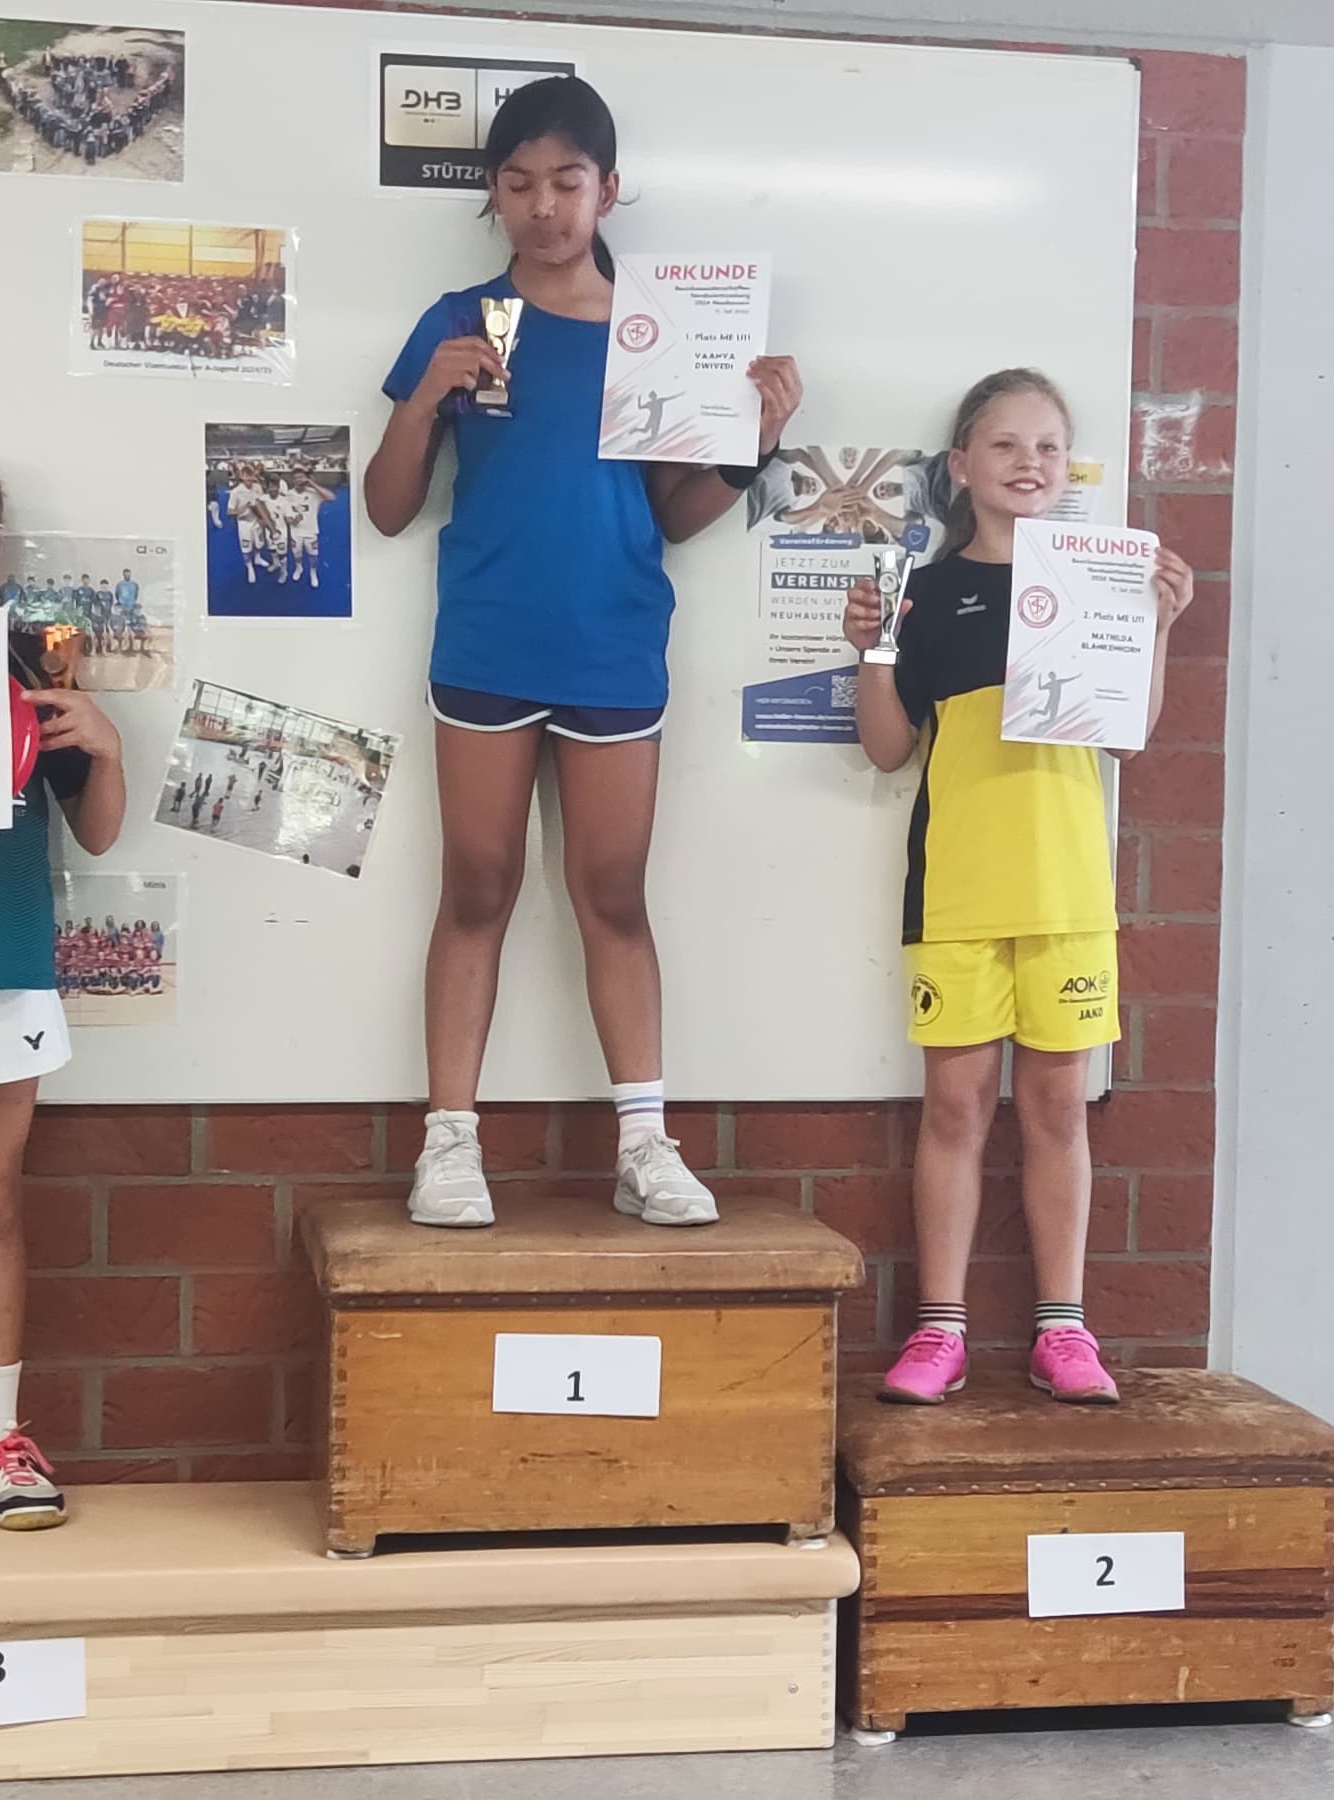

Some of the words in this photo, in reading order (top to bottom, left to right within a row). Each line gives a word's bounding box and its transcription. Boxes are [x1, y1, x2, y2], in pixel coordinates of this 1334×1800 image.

[400, 89, 462, 110] DHB
[422, 162, 484, 180] STÜTZP
[655, 263, 757, 280] URKUNDE
[1052, 533, 1151, 558] URKUNDE
[821, 558, 850, 569] ZUM
[774, 574, 855, 588] VEREINS
[771, 611, 841, 620] NEUHAUSEN
[1059, 976, 1098, 994] AOK
[567, 1370, 586, 1402] 1
[1095, 1555, 1116, 1587] 2
